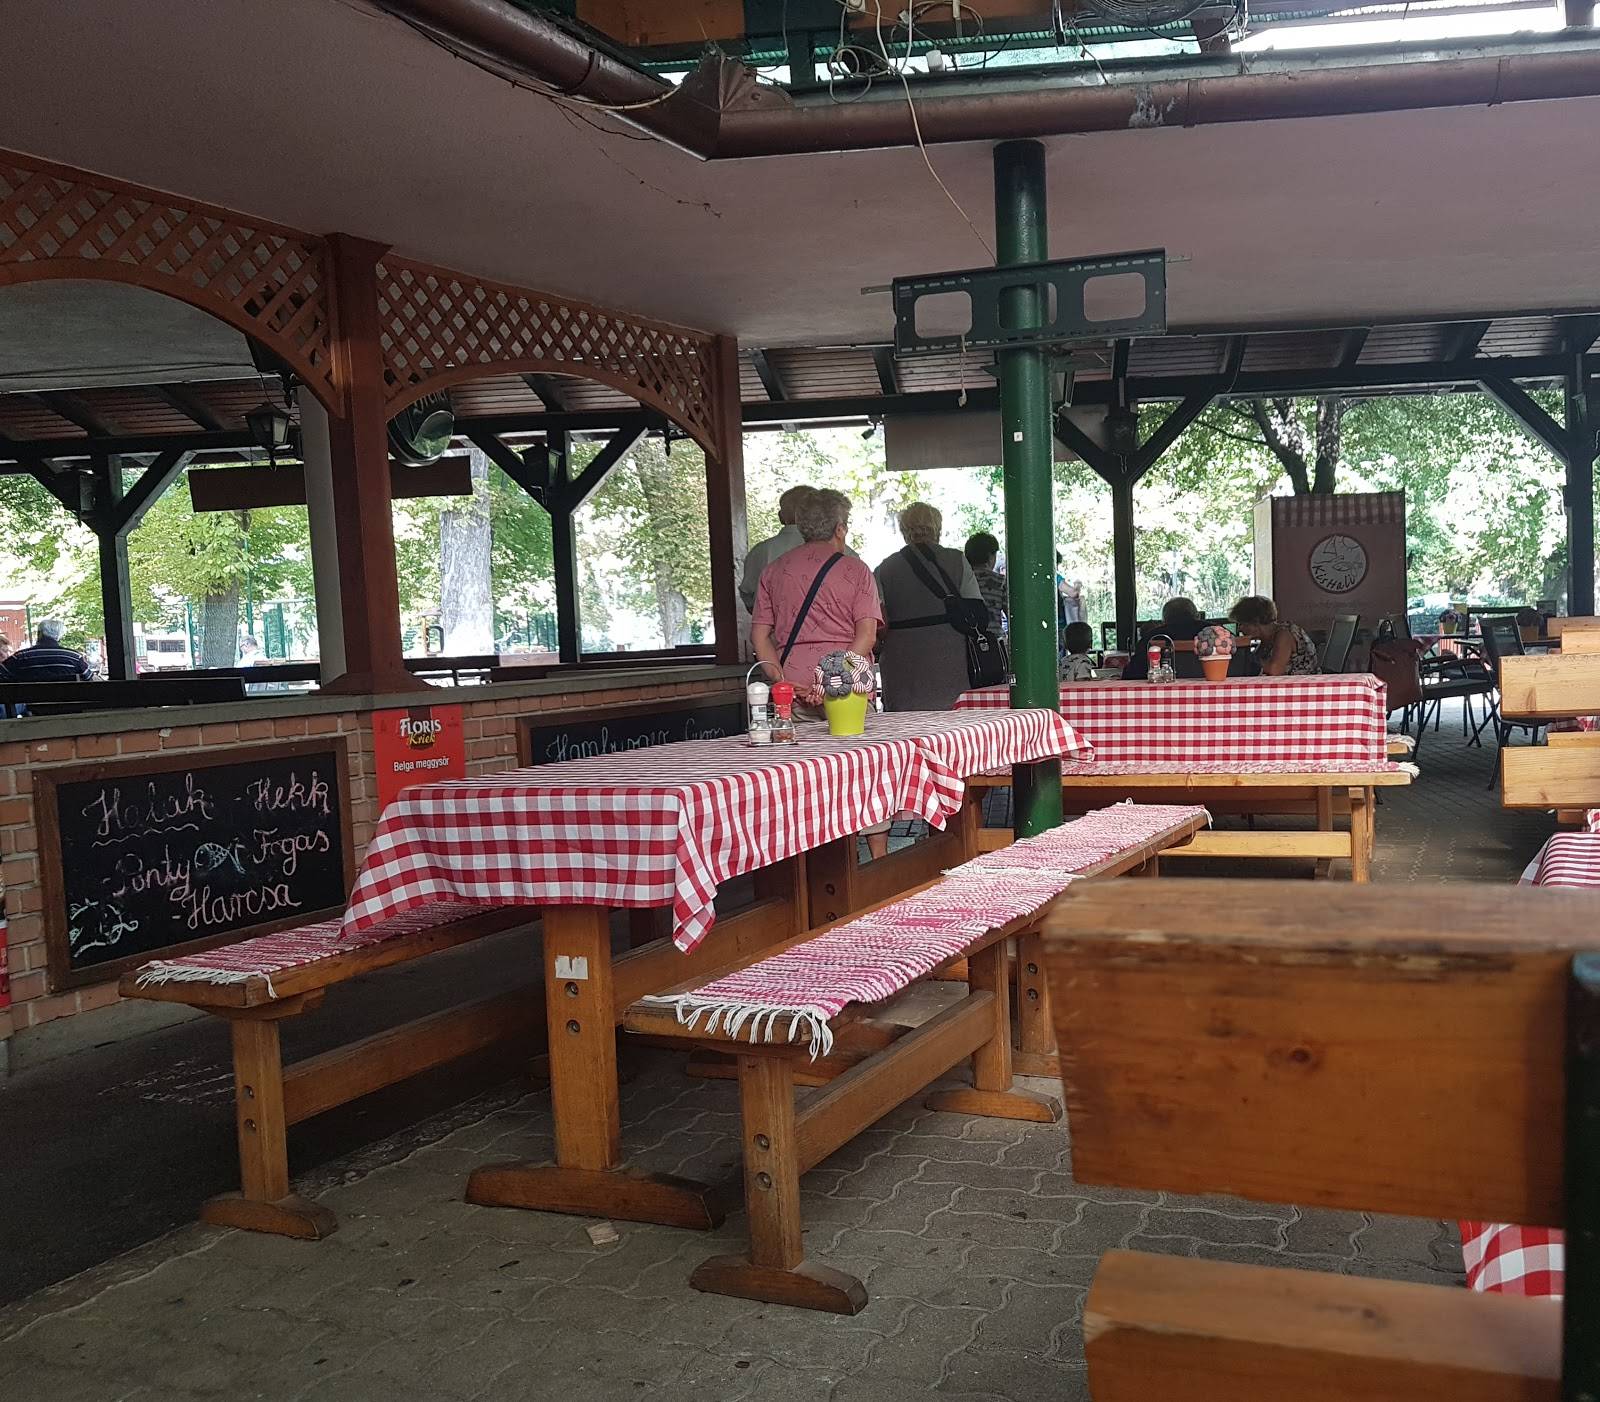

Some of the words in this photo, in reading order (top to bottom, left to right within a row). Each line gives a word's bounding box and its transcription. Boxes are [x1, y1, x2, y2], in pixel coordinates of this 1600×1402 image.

[400, 717, 441, 737] FLORIS
[408, 731, 436, 745] Kriek
[393, 761, 415, 772] Belga
